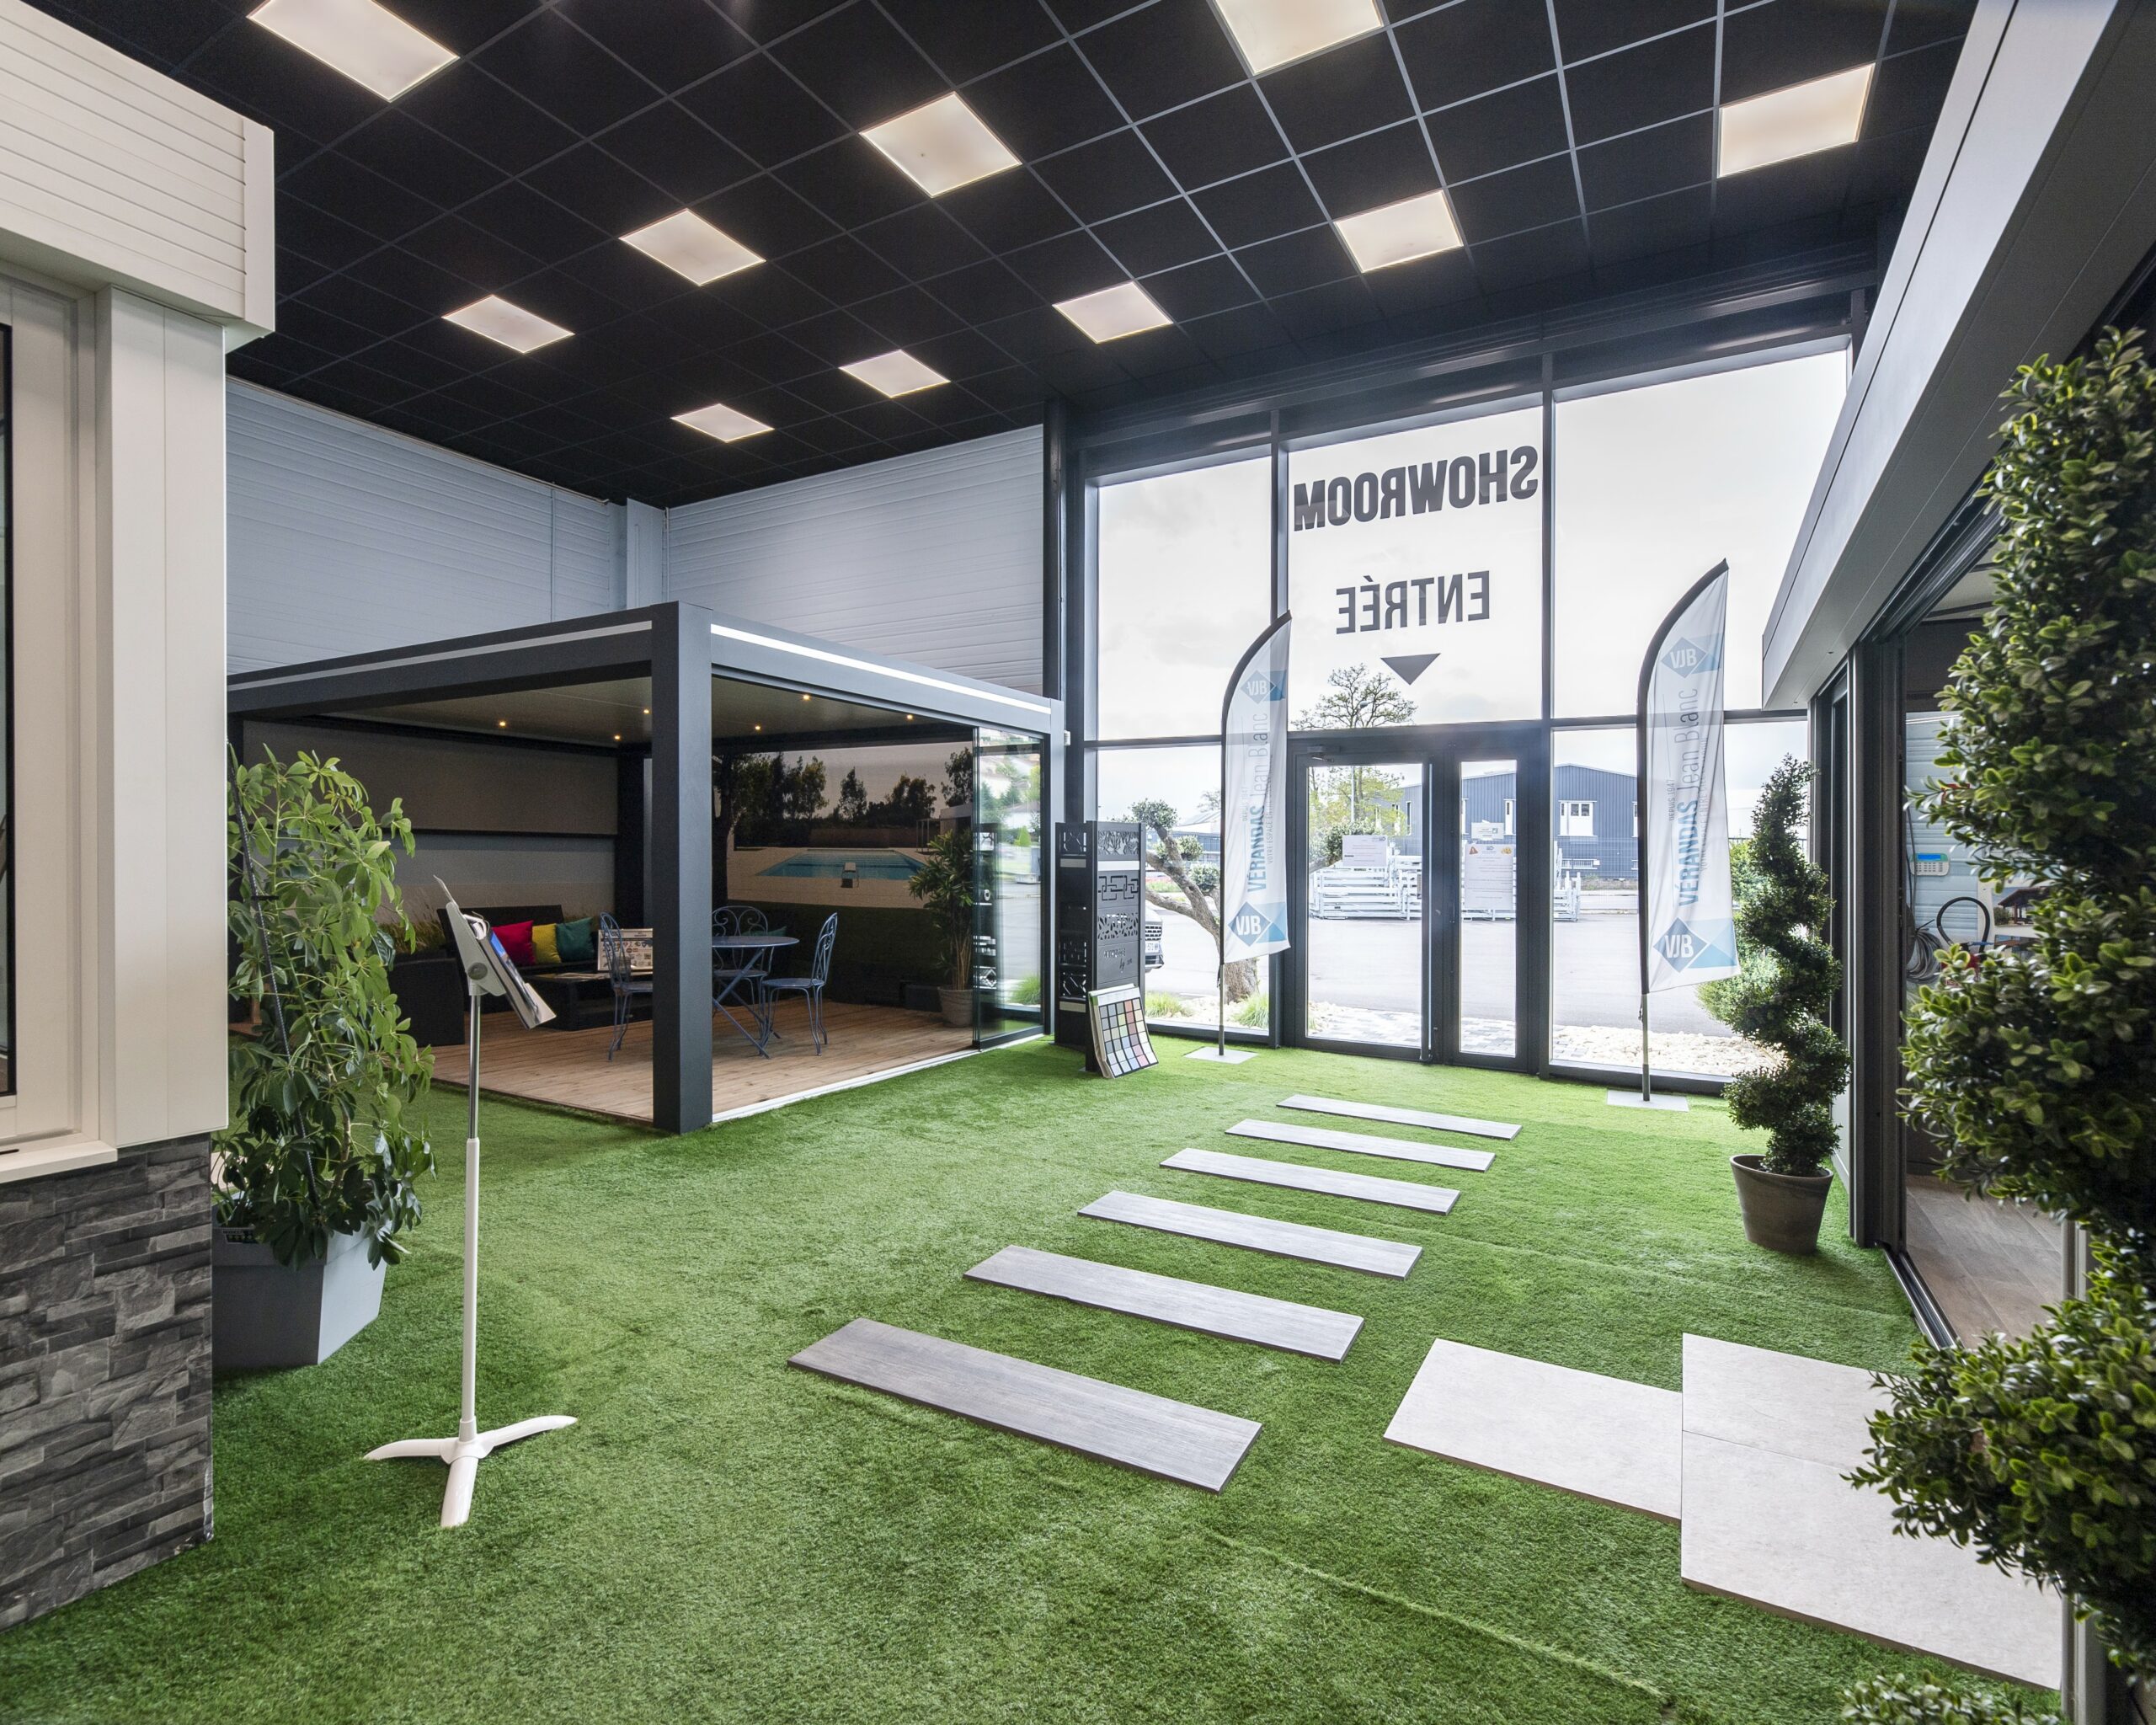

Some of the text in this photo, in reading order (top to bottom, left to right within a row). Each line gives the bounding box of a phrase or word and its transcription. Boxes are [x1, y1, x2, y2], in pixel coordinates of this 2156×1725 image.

[1669, 648, 1698, 670] VJB
[1246, 680, 1267, 697] VJB
[1247, 713, 1269, 893] VÉRANDAS Jean Blanc
[1668, 797, 1676, 821] DEPUIS
[1673, 688, 1700, 907] VÉRANDAS Jean Blanc
[1235, 916, 1262, 936] VJB
[1664, 934, 1694, 959] VJB
